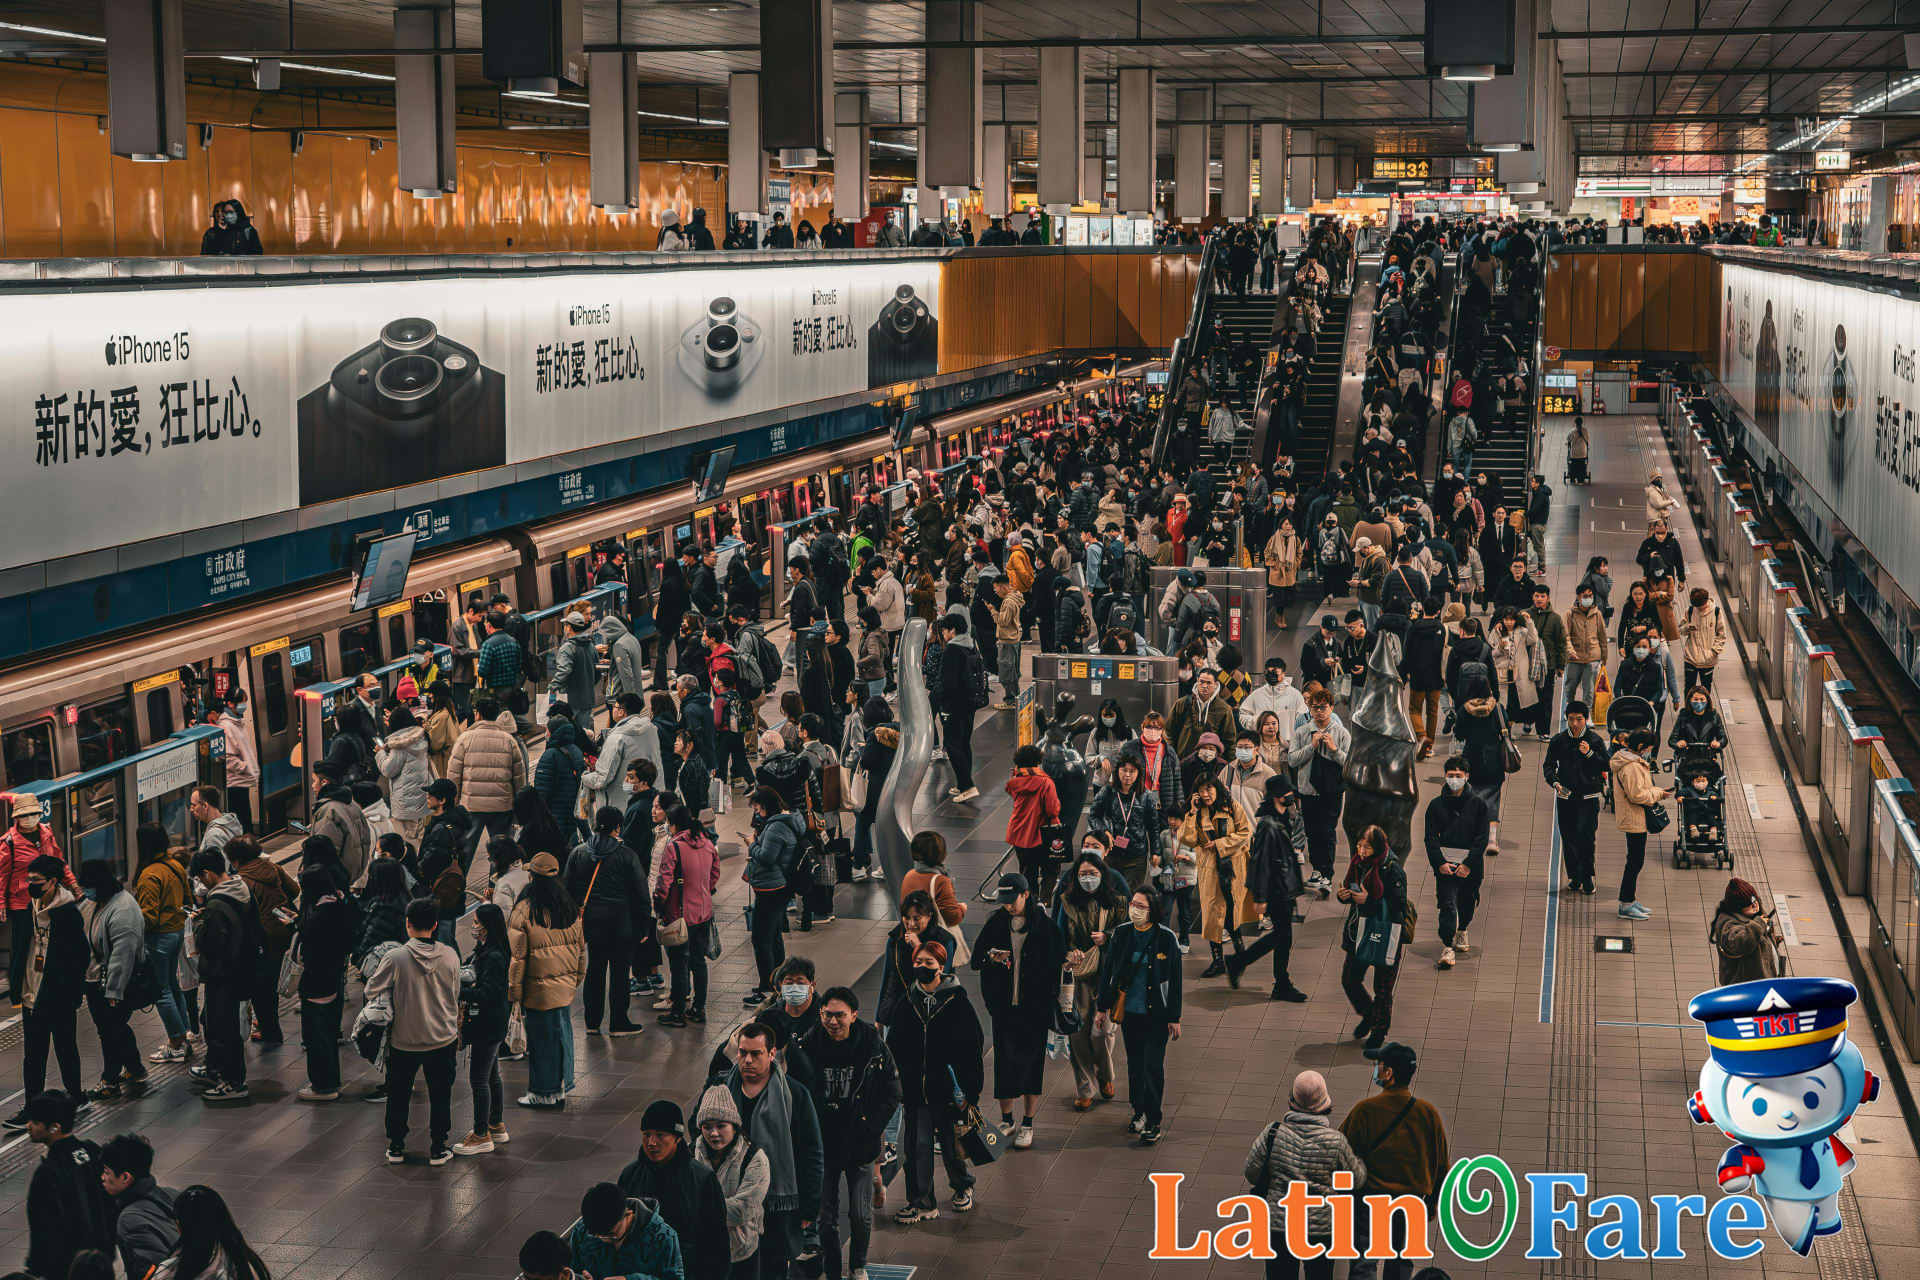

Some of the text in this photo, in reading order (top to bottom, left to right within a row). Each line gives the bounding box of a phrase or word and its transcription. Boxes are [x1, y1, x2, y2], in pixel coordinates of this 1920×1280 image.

[1407, 163, 1417, 178] 3
[575, 303, 611, 326] iPhone 15
[118, 331, 190, 365] iPhone 15
[214, 549, 246, 575] 市政府
[329, 696, 335, 711] 3
[219, 736, 225, 752] 3
[44, 799, 51, 817] 3
